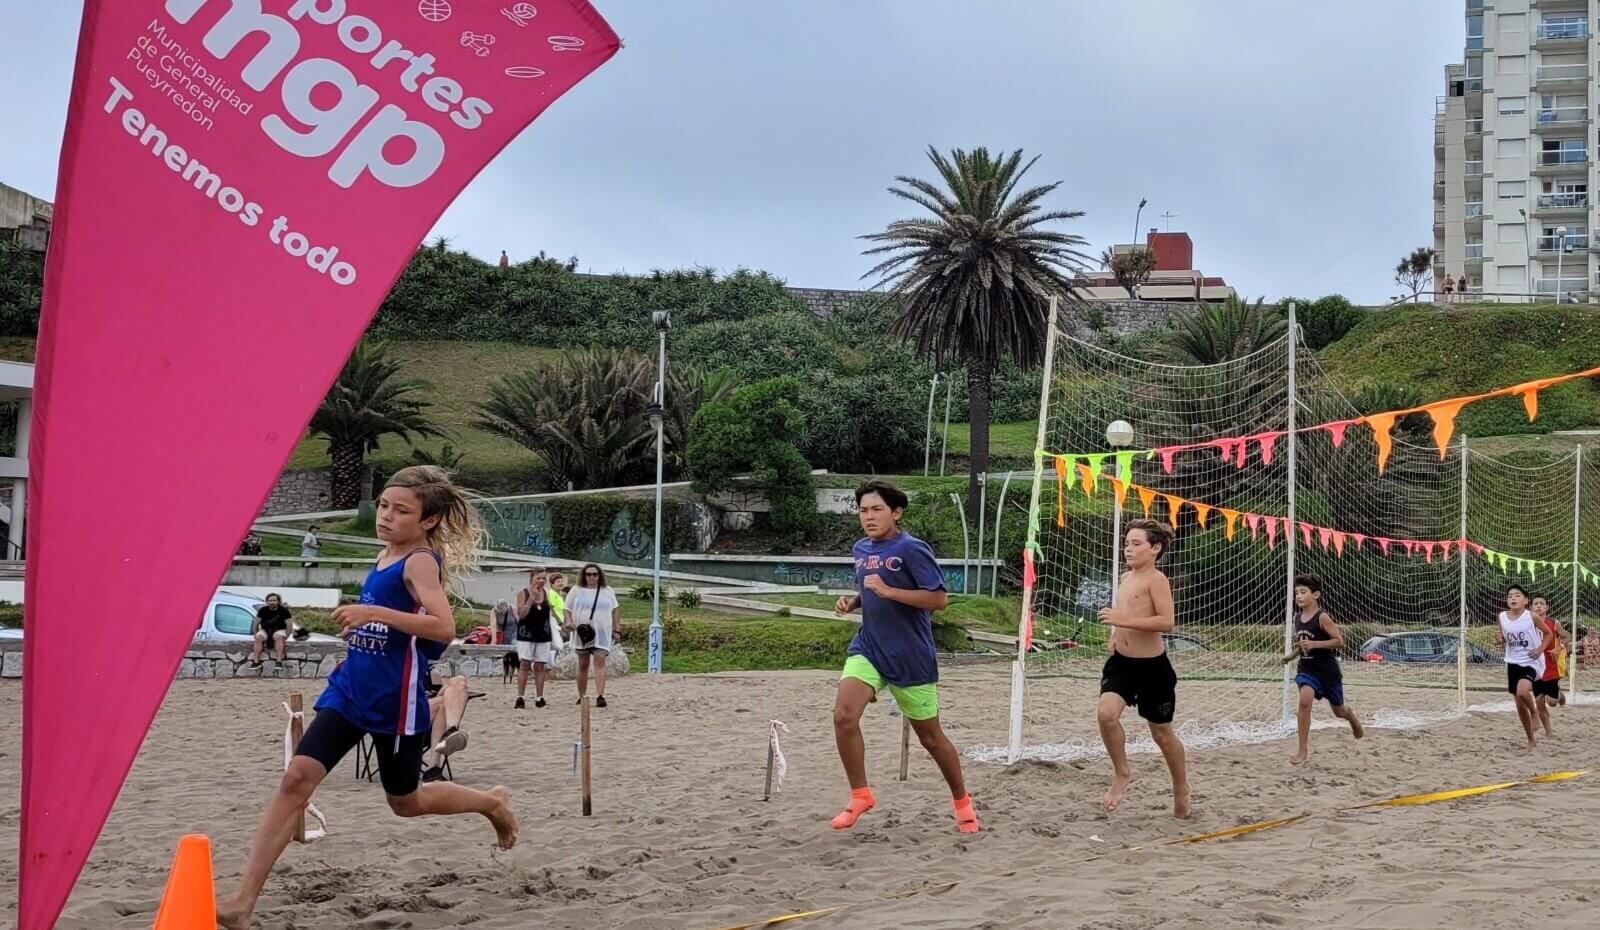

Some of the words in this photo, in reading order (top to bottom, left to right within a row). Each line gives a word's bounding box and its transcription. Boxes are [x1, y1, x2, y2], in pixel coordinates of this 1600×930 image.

[126, 47, 214, 131] Pueyrredon
[137, 35, 158, 58] de
[159, 54, 221, 113] General
[147, 18, 254, 116] Municipalidad
[164, 0, 445, 189] mgp
[288, 0, 494, 130] portes
[103, 76, 264, 227] Tenemos
[269, 215, 357, 286] todo
